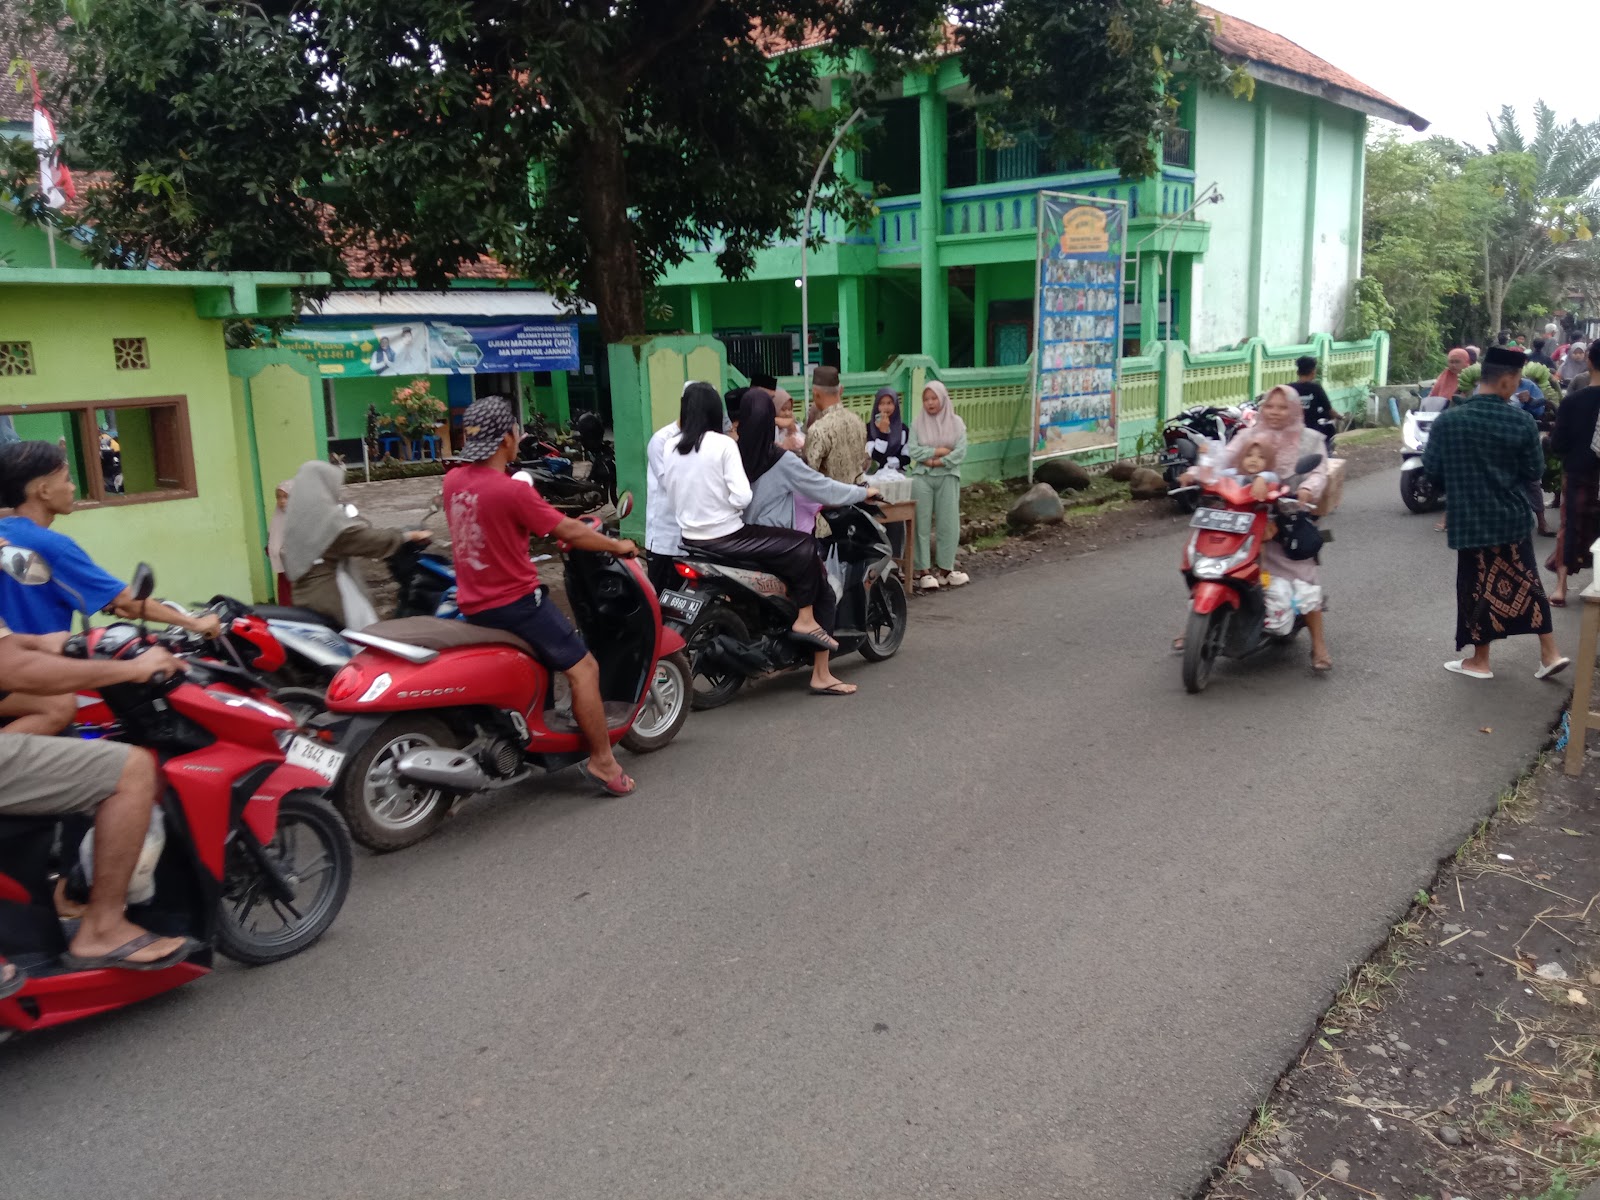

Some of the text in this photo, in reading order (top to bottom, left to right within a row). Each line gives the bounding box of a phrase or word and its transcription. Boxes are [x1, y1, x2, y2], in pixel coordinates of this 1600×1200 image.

[488, 338, 572, 348] UJIAN MADRASAH (UM)
[511, 348, 543, 356] MIFTAHUL
[544, 348, 571, 356] JANNAH
[661, 593, 670, 604] N
